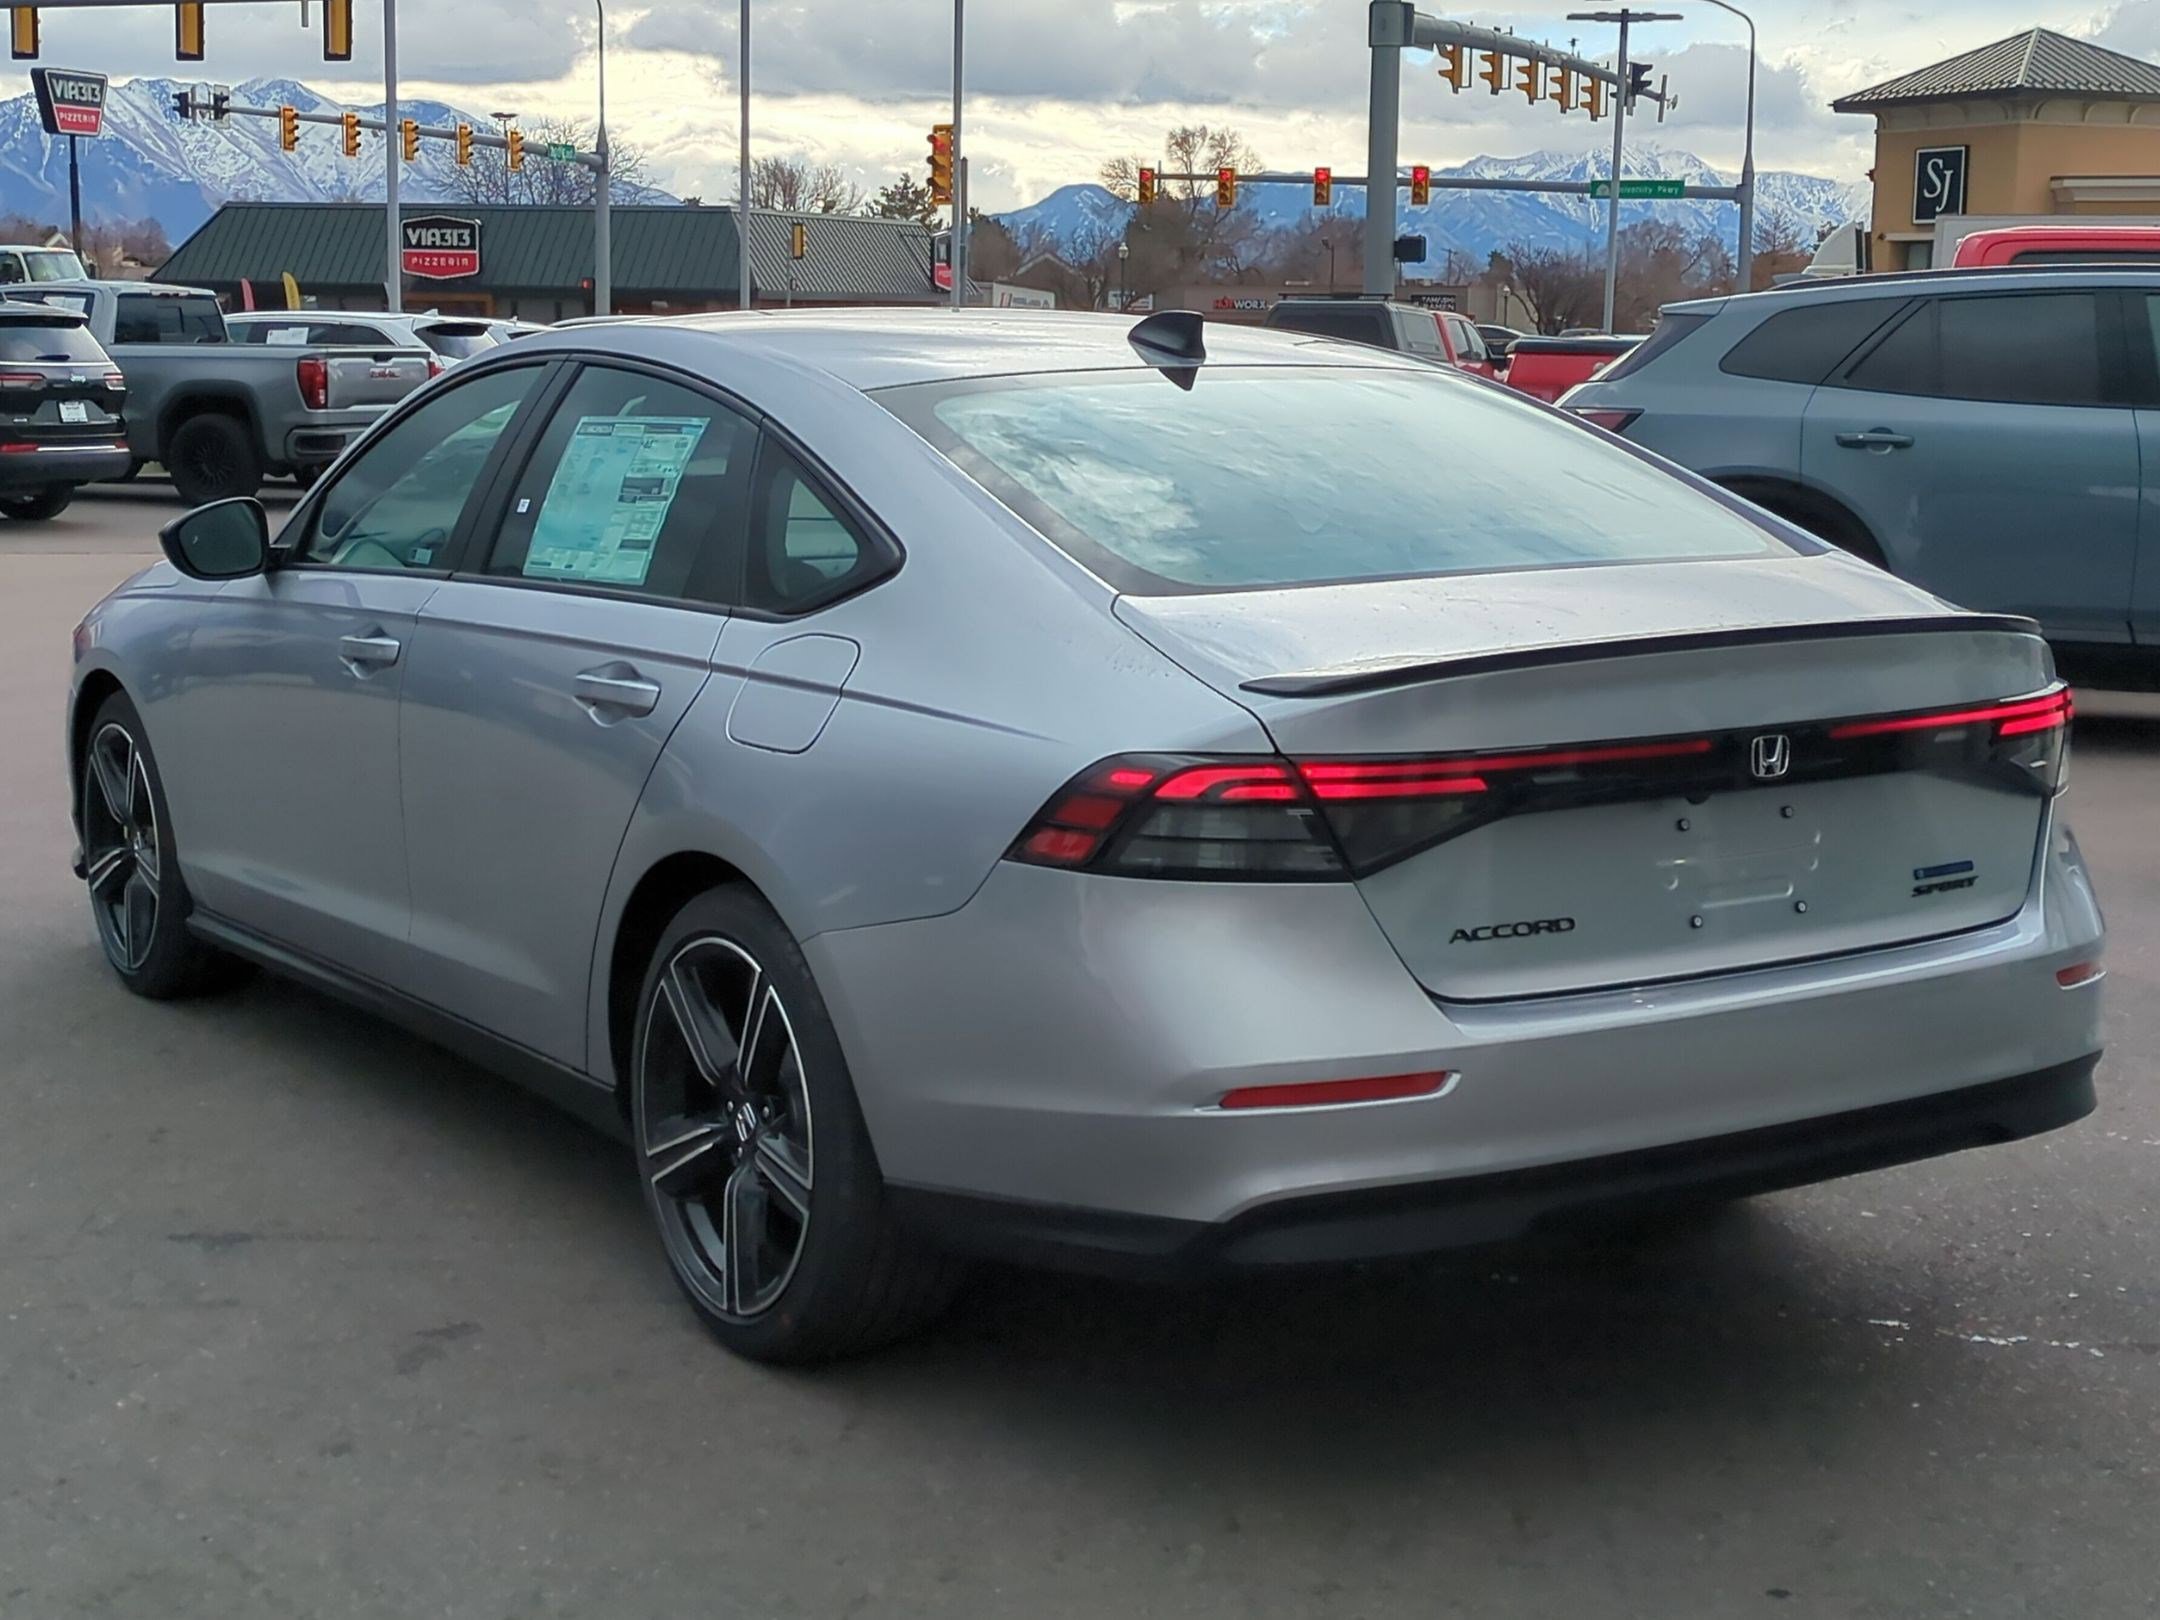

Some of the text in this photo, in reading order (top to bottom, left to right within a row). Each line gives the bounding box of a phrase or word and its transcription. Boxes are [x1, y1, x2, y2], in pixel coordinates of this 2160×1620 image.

[59, 111, 96, 124] PIZZERIA
[411, 255, 469, 267] PIZZERIA
[1911, 875, 1979, 898] SPORT
[1449, 917, 1576, 945] ACCORD
